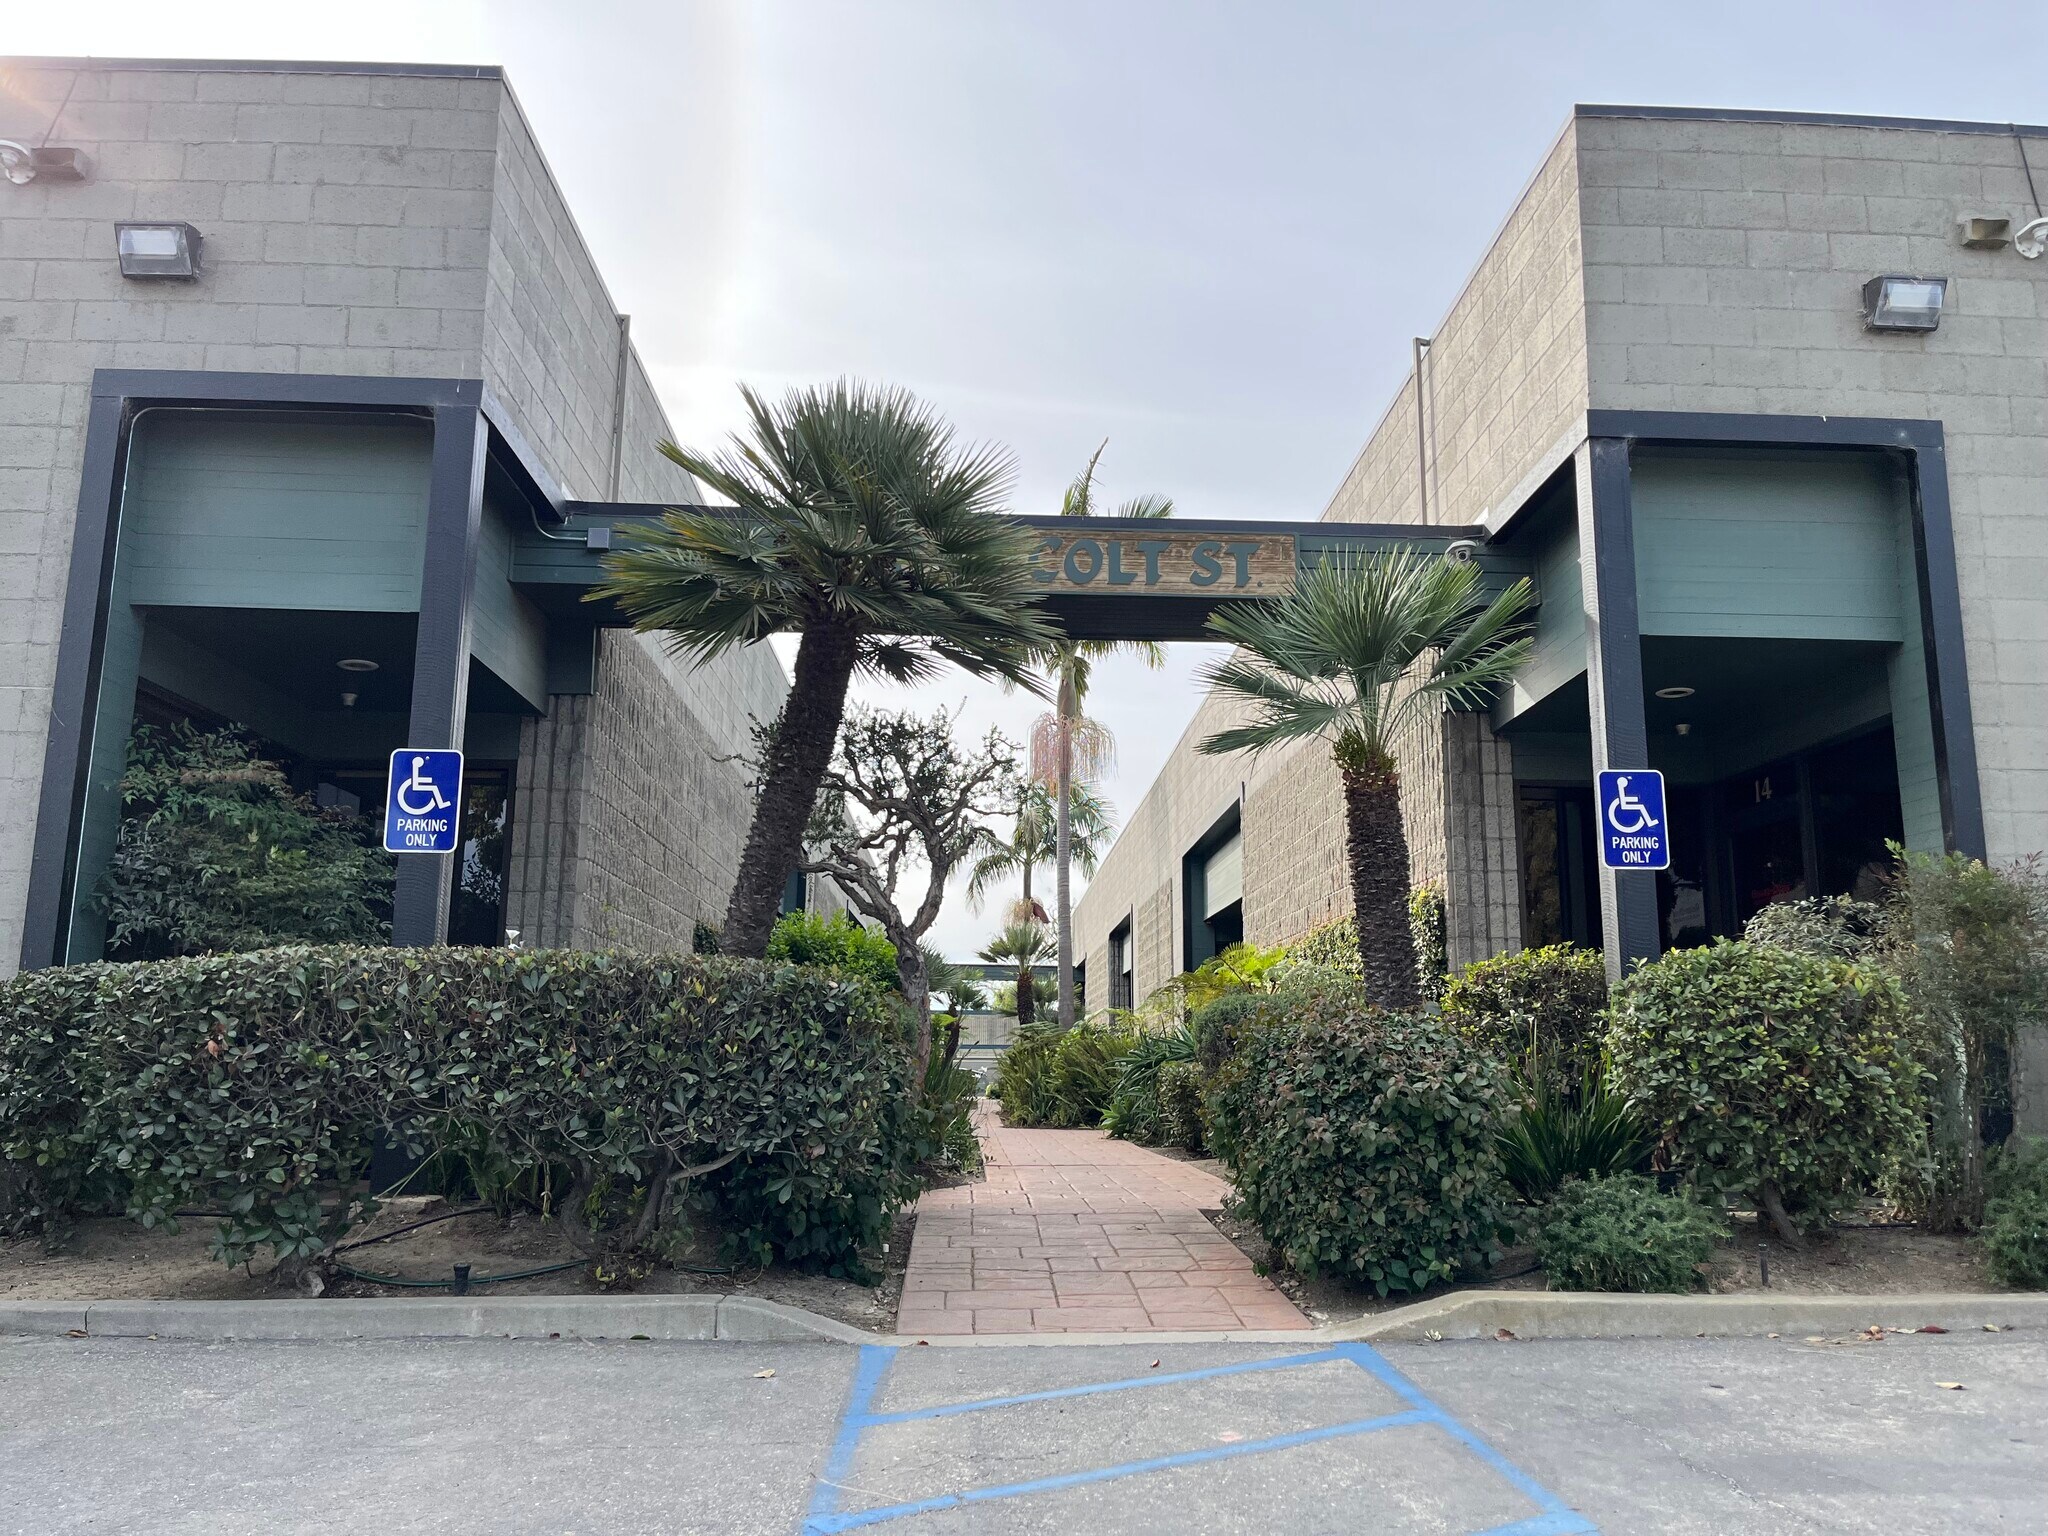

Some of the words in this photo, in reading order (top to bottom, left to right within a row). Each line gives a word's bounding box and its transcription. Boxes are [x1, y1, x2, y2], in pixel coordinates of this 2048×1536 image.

[1030, 536, 1172, 585] COLT
[1755, 776, 1773, 803] 14
[397, 818, 448, 831] PARKING
[405, 833, 437, 846] ONLY
[1612, 836, 1659, 849] PARKING
[1622, 851, 1651, 863] ONLY
